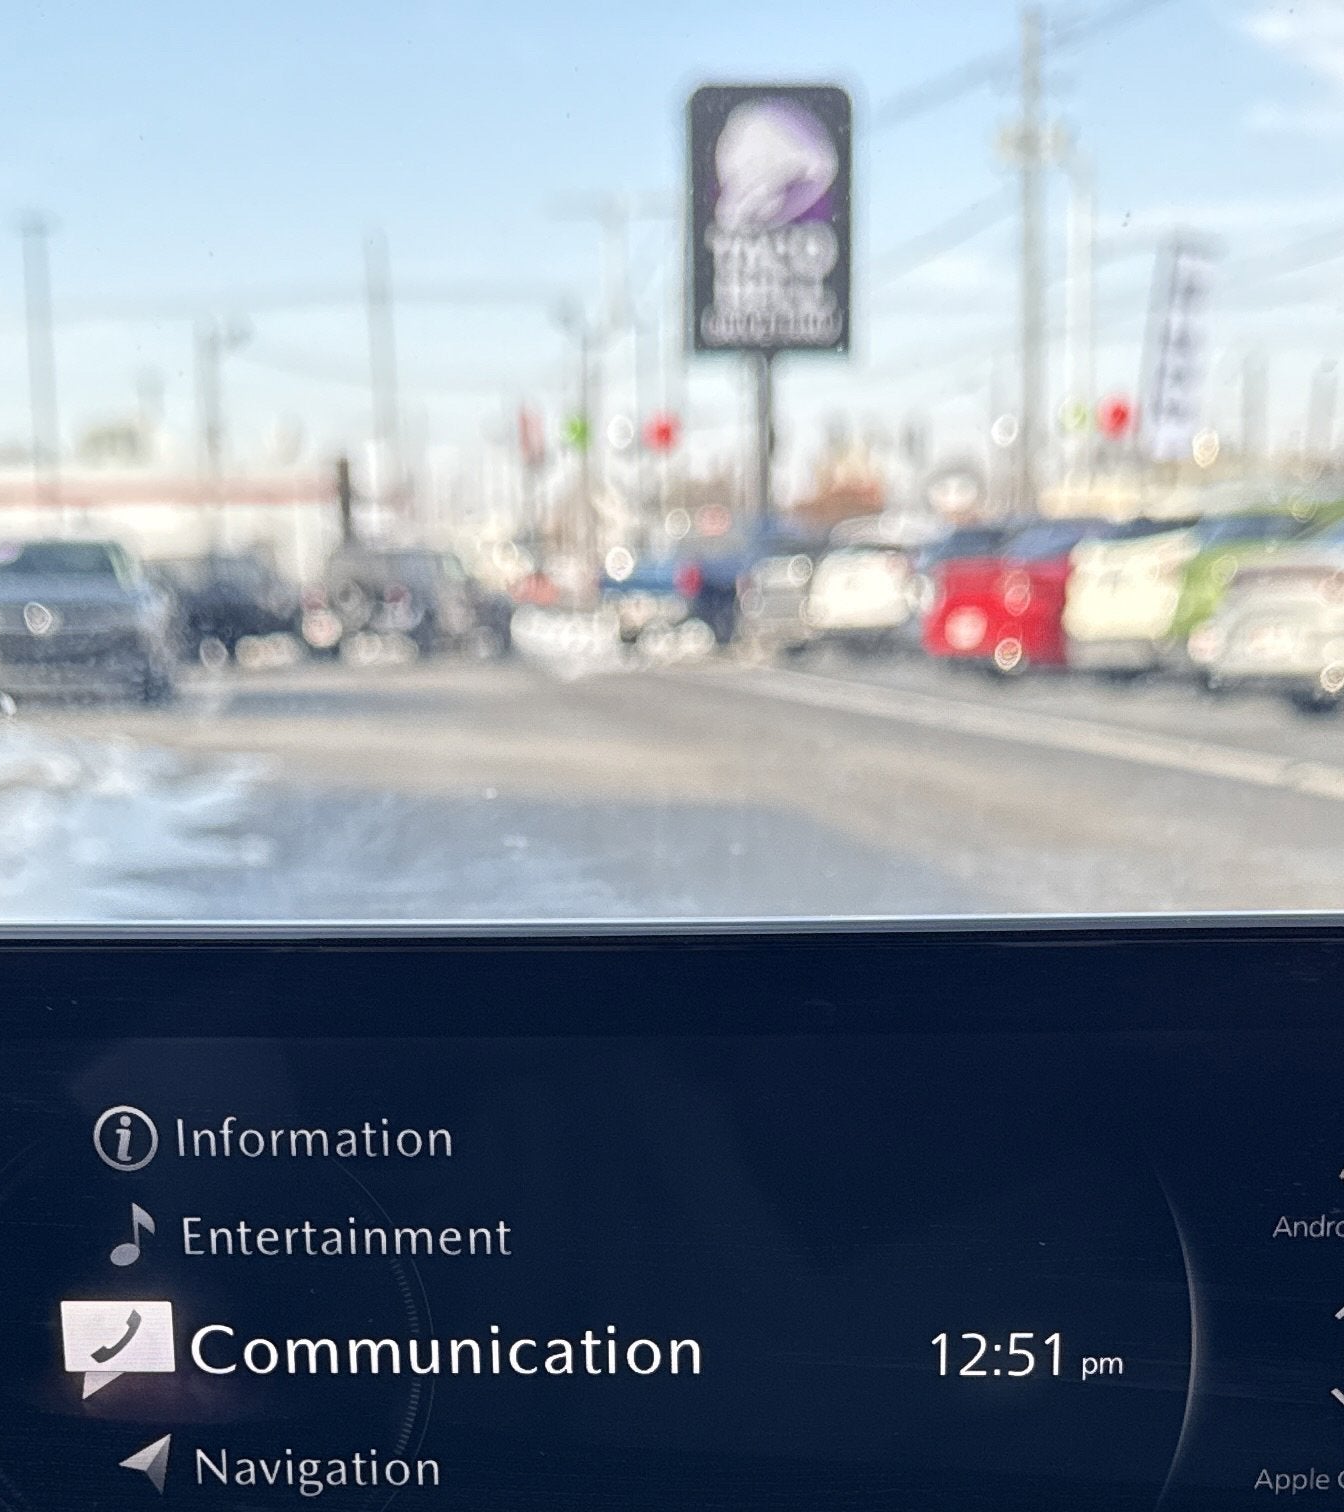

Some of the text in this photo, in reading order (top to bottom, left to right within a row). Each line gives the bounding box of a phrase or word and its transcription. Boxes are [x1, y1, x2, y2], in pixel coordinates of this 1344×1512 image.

[174, 1115, 453, 1158] Information
[181, 1215, 513, 1257] Entertainment
[190, 1323, 703, 1377] Communication
[930, 1331, 1125, 1382] 12:51 pm
[195, 1447, 441, 1497] Navigation
[1254, 1467, 1331, 1496] Apple
